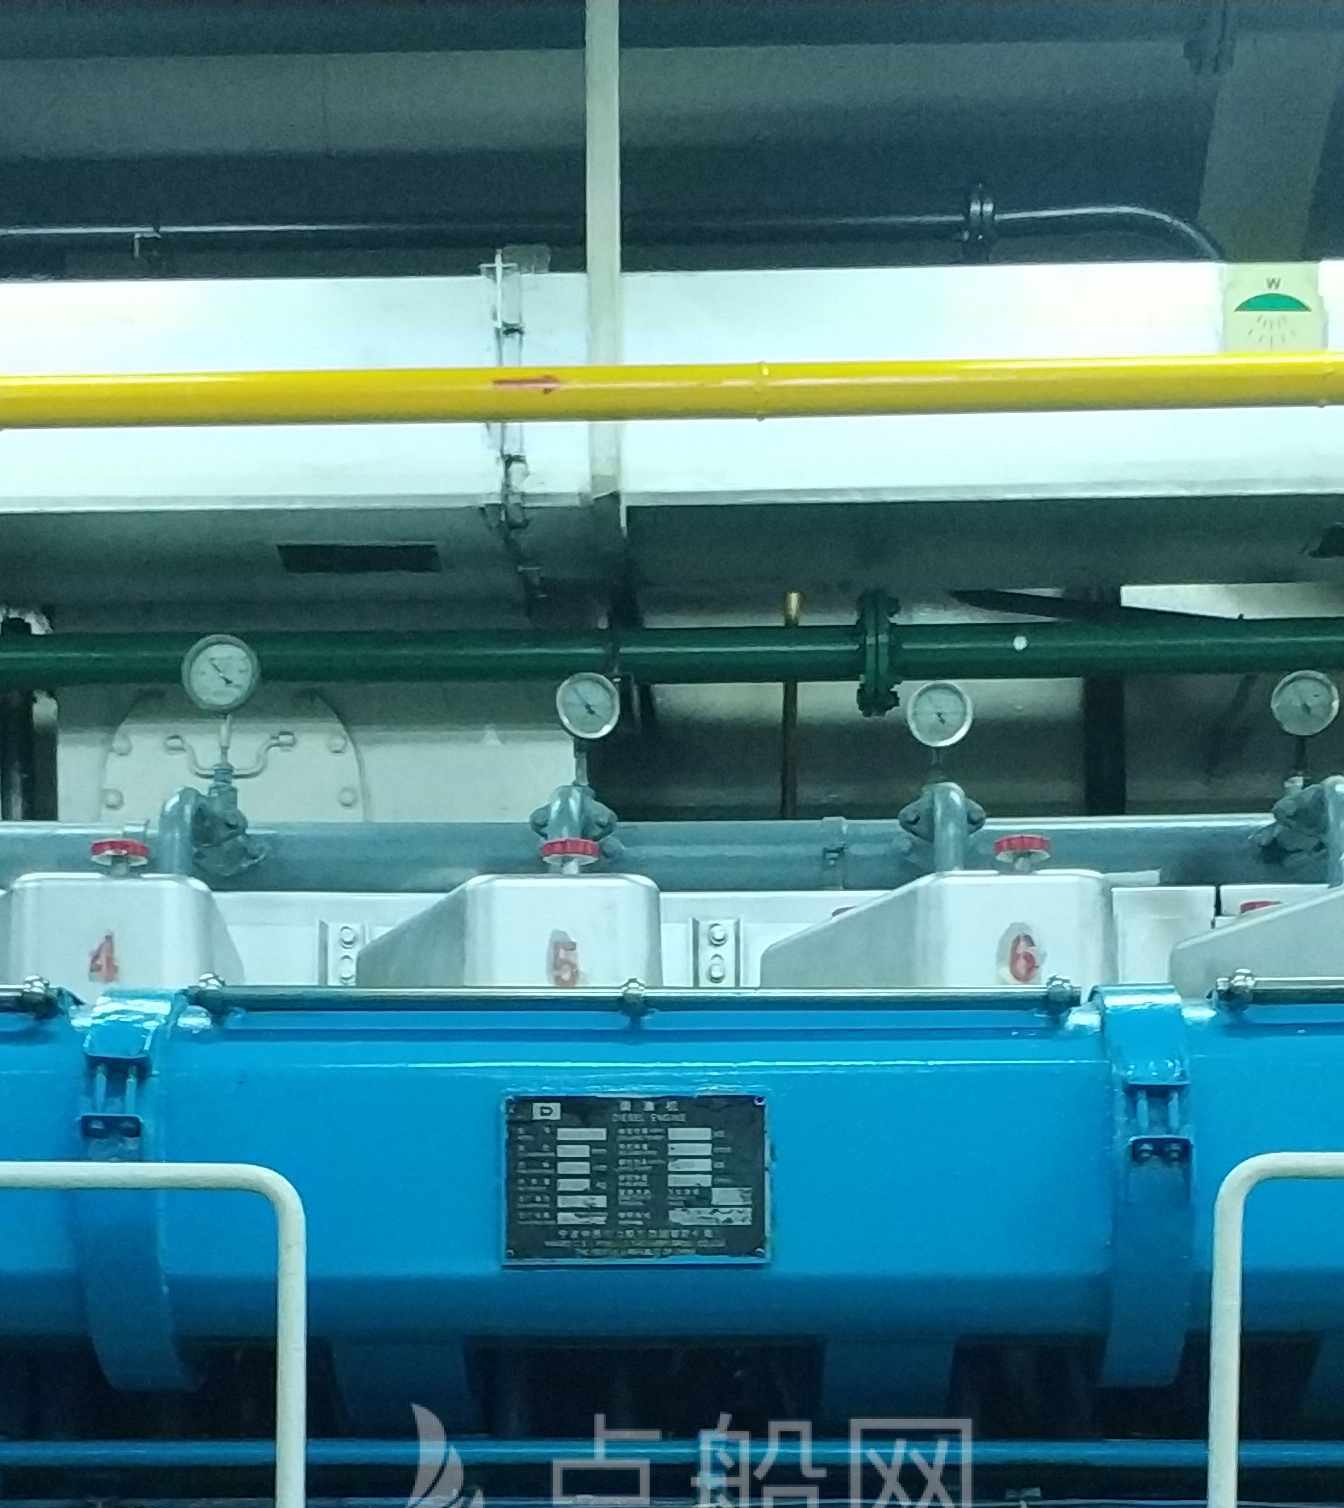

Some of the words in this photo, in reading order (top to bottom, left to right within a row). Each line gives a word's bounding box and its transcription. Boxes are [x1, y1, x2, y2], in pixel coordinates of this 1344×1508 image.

[1266, 277, 1281, 290] W
[88, 930, 119, 983] 4
[1009, 939, 1039, 984] 6
